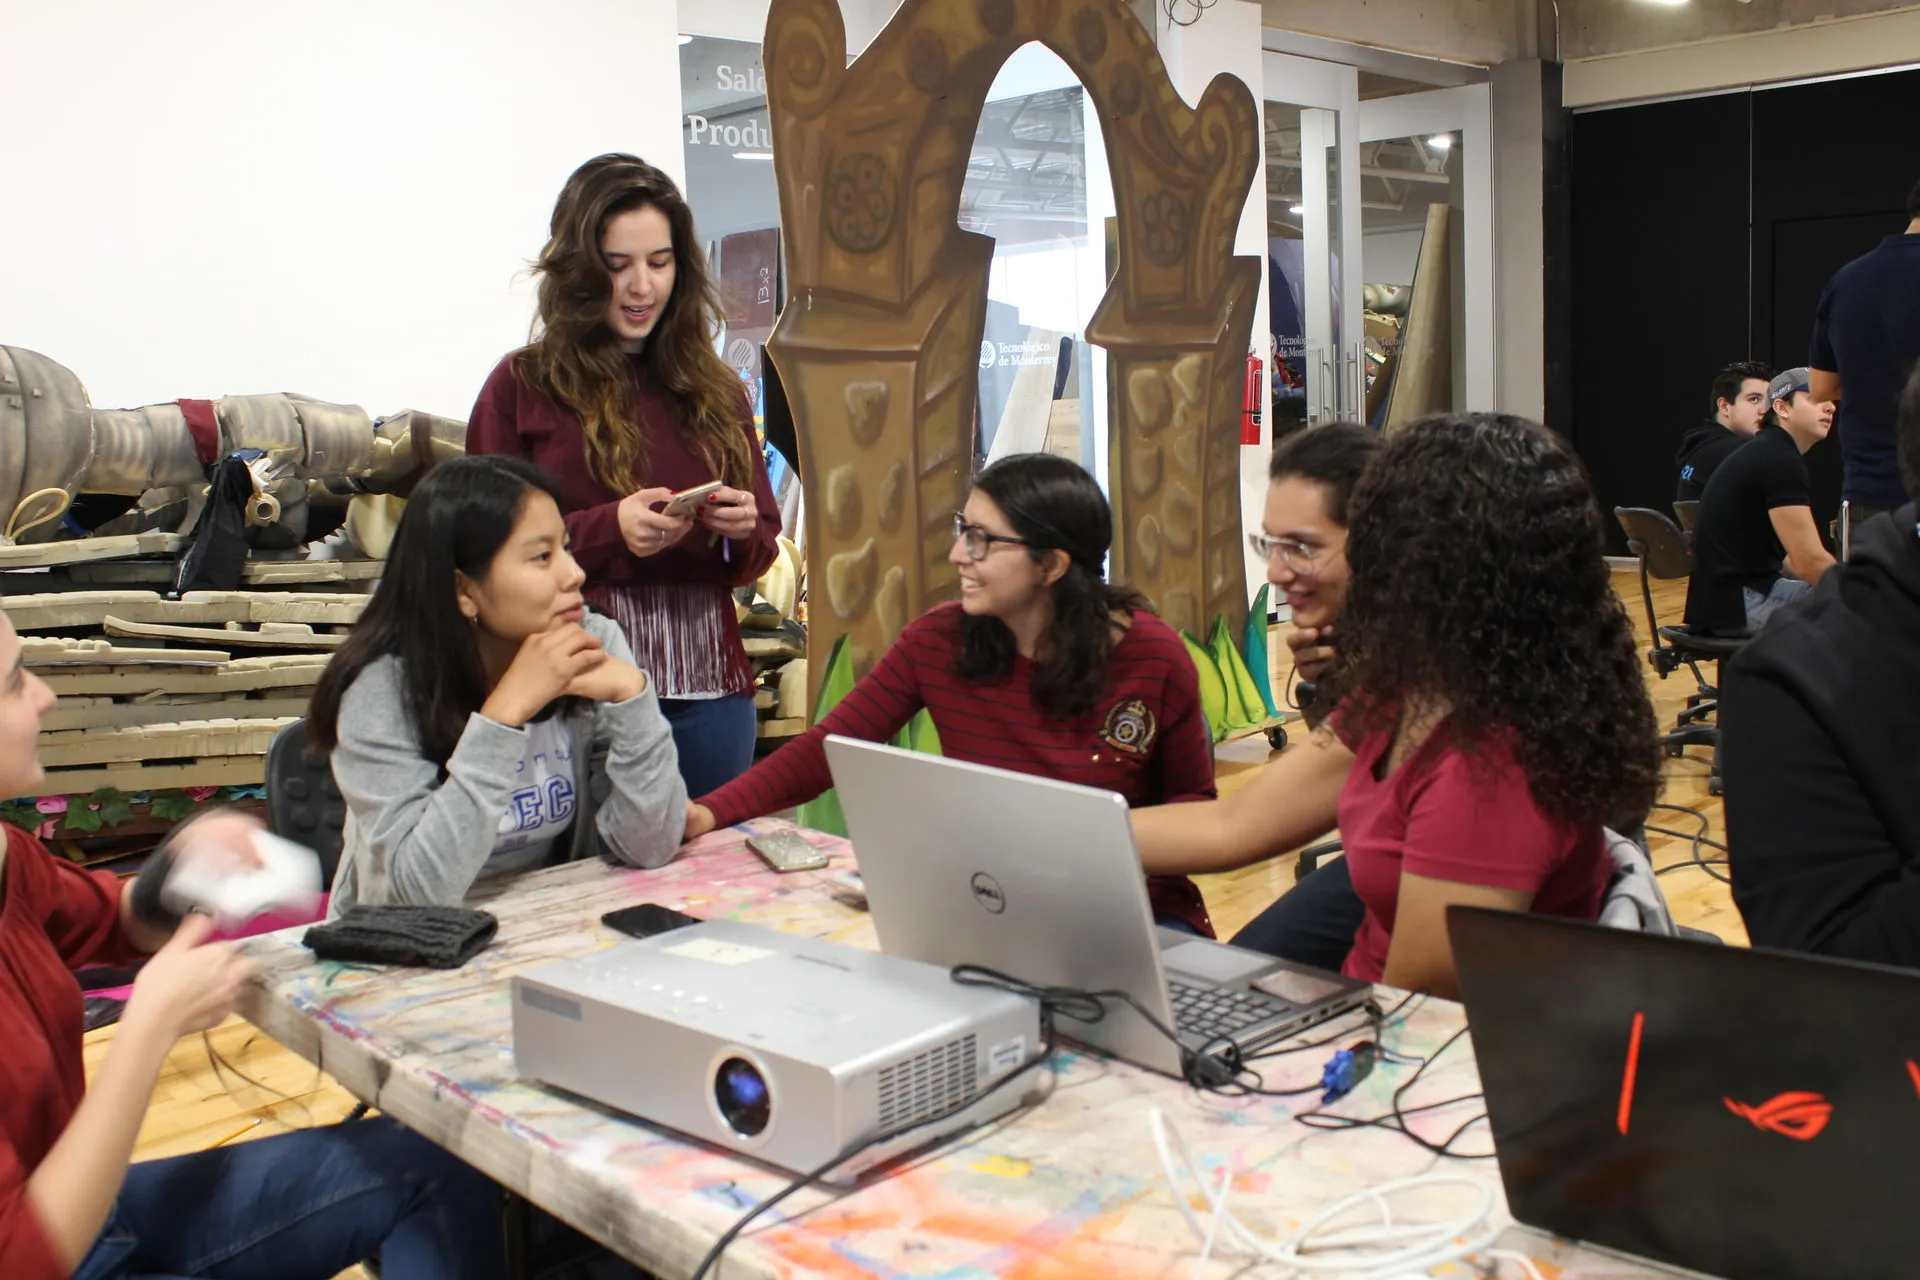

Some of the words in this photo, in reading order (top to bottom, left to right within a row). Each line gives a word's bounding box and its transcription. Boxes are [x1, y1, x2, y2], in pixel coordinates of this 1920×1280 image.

[997, 340, 1051, 355] Tecnológico
[998, 355, 1009, 367] de
[1010, 354, 1057, 367] Monterrey
[500, 774, 575, 833] EC
